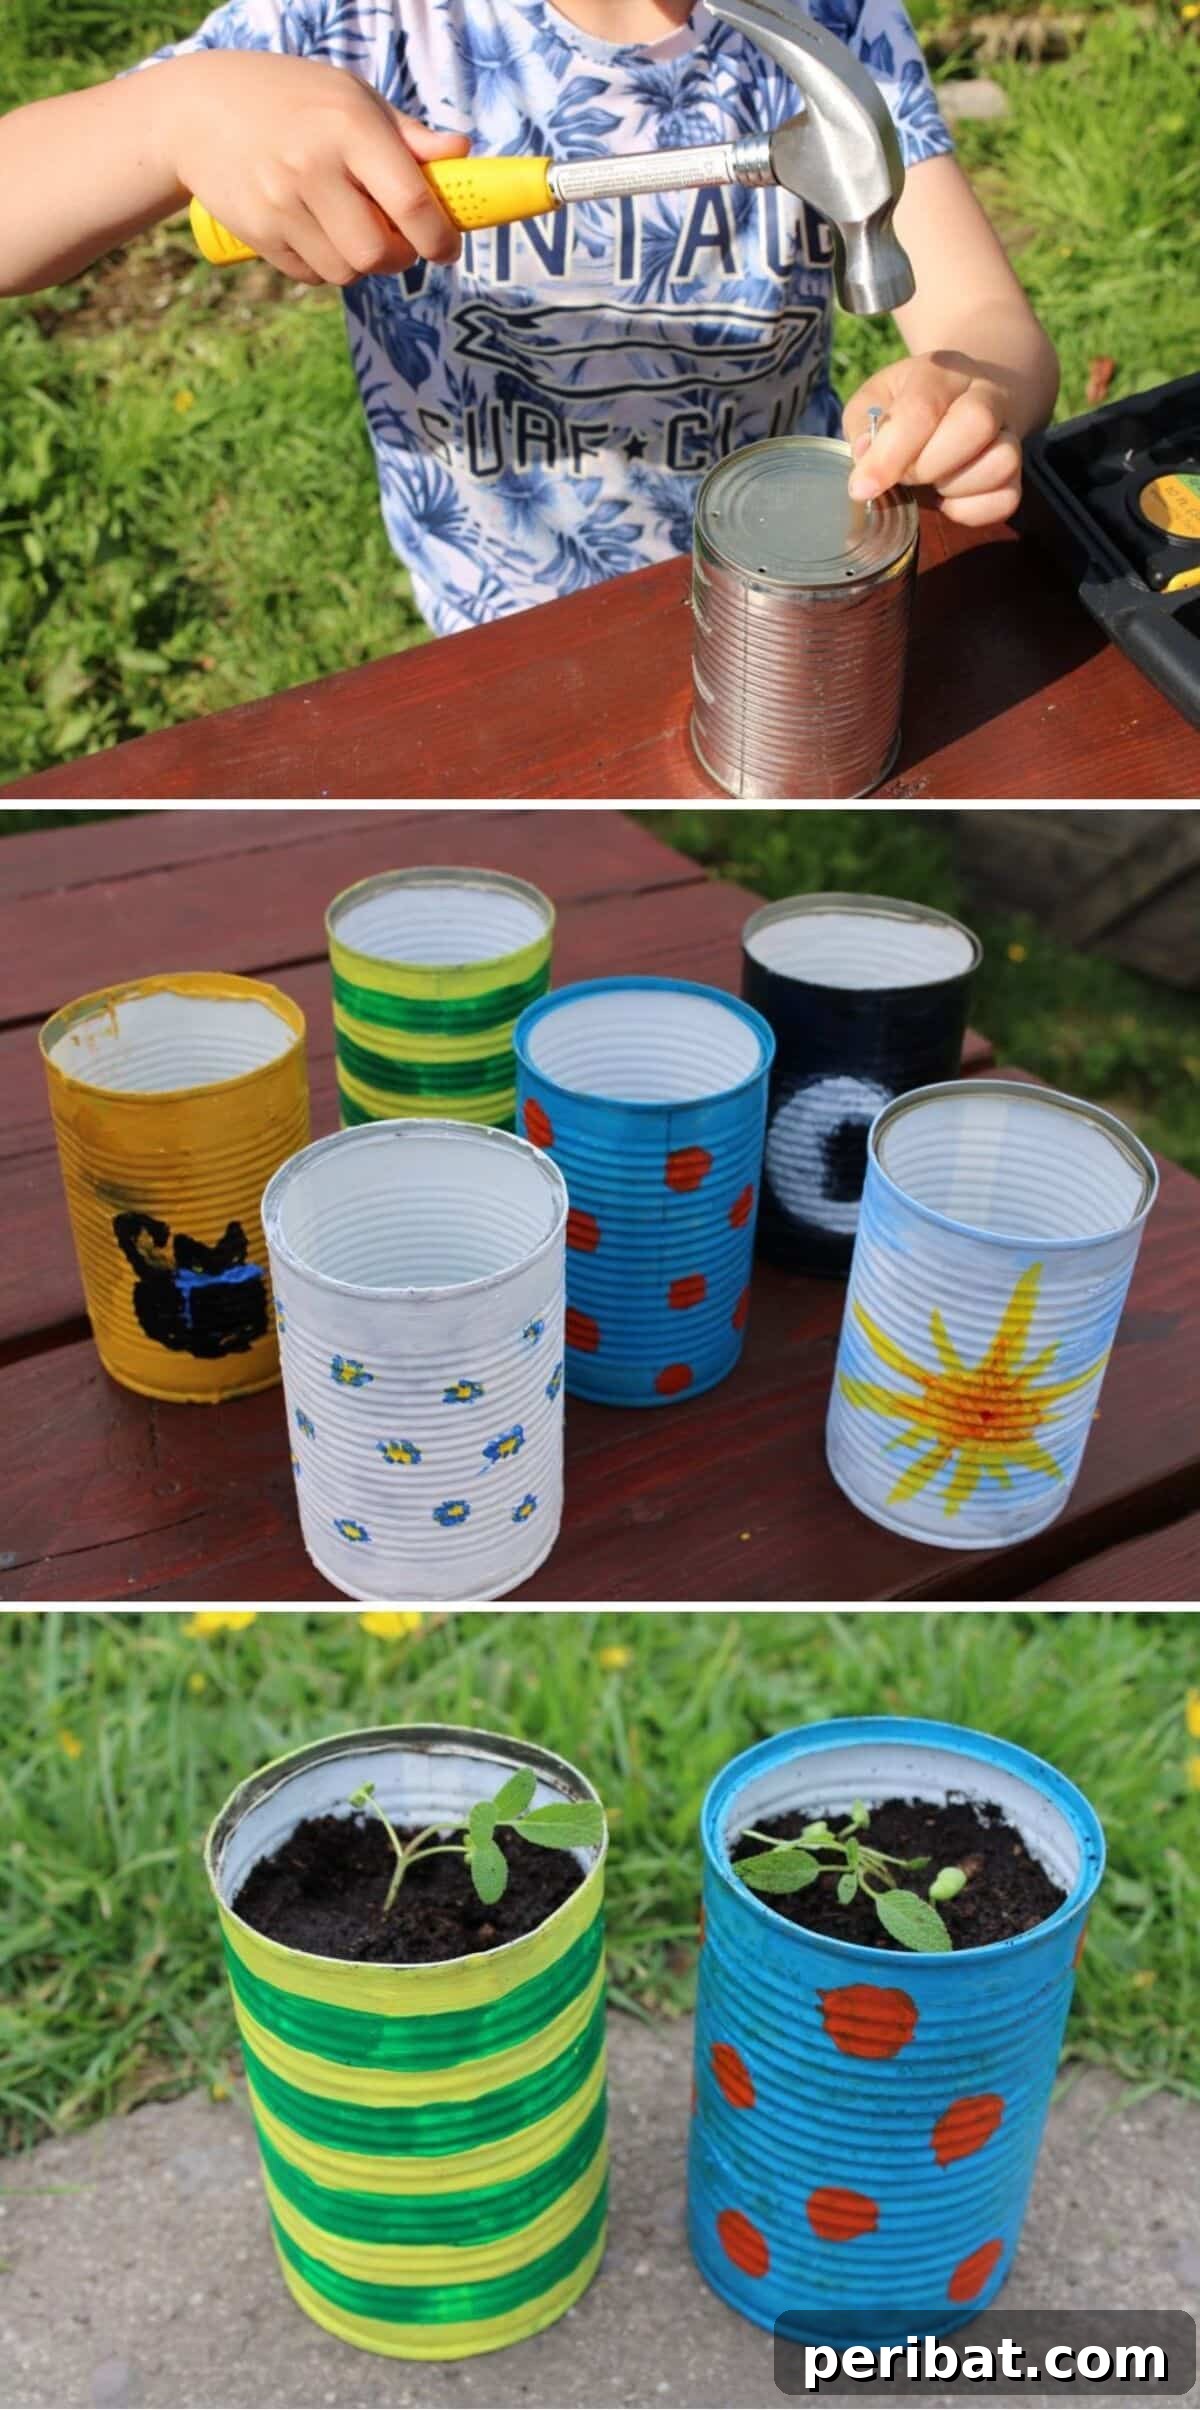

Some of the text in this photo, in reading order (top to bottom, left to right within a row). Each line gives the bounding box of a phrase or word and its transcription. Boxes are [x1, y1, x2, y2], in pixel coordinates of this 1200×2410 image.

[400, 185, 834, 298] NTAGE
[417, 385, 808, 479] SURF CLU
